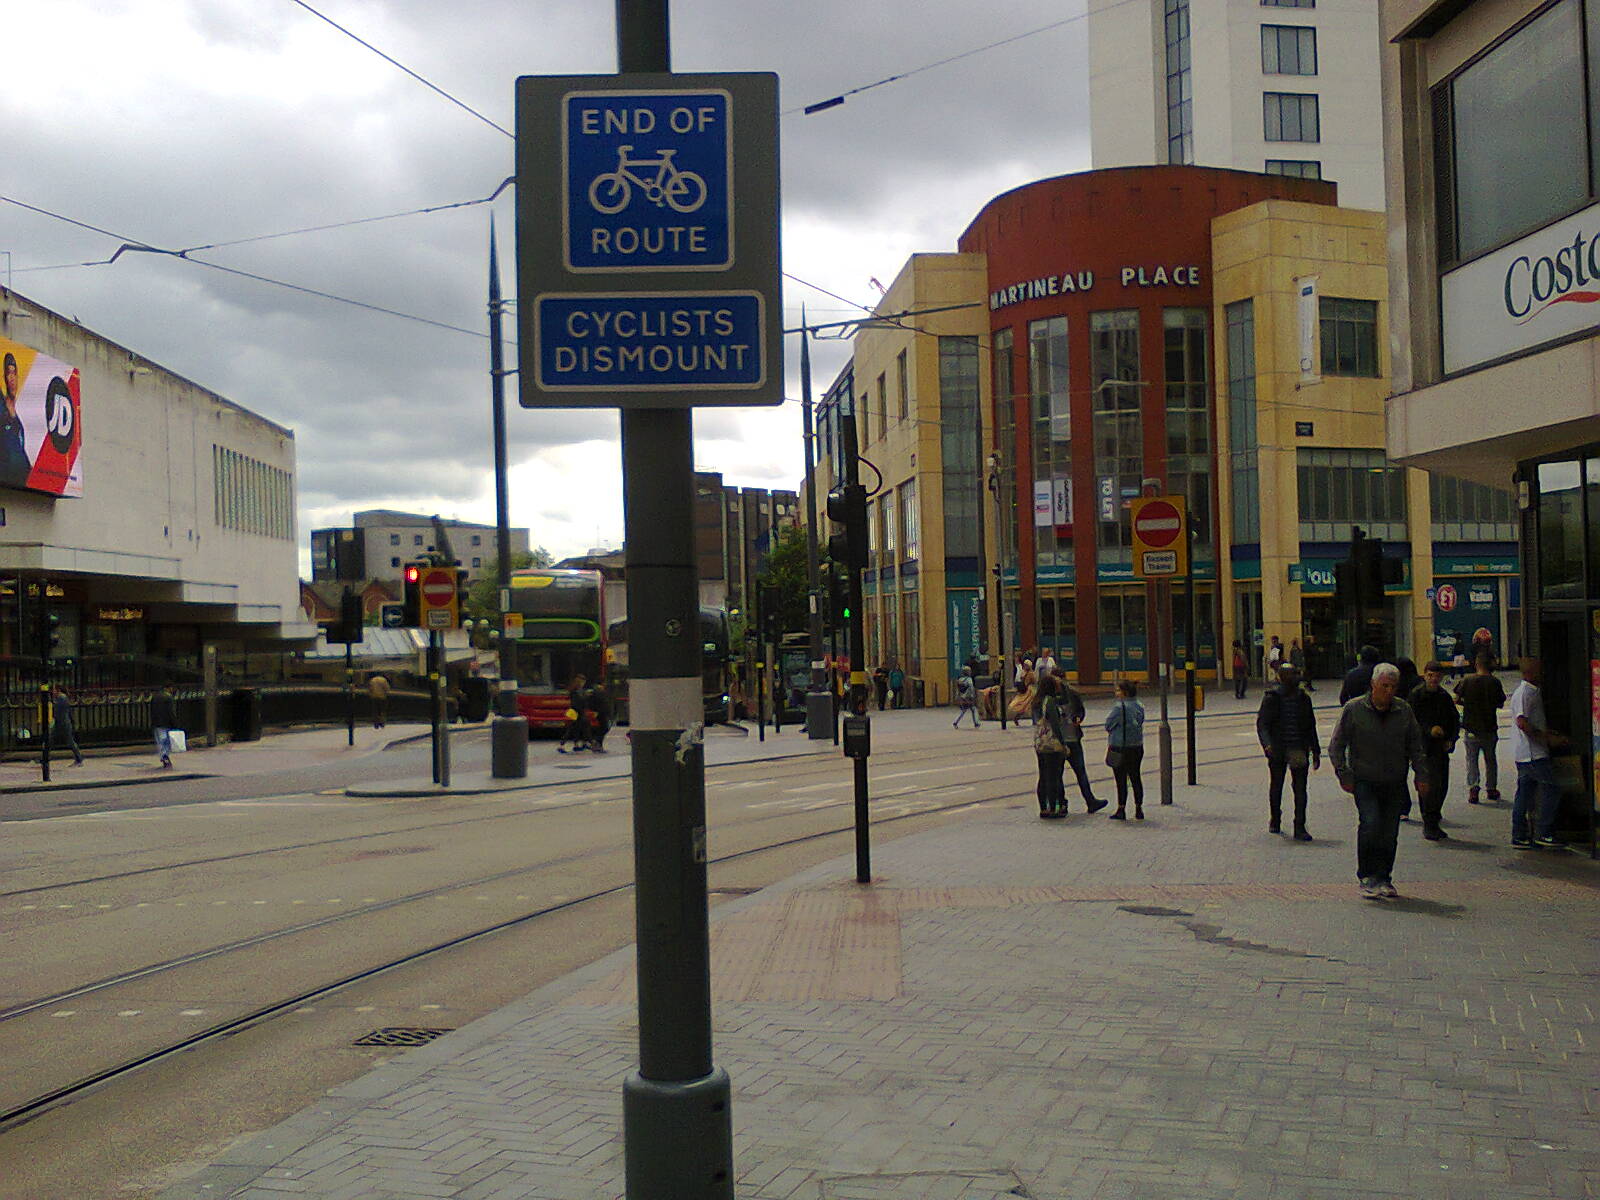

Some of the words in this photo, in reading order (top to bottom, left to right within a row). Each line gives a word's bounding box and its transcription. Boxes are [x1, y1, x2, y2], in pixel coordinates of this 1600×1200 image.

[582, 108, 655, 134] END
[670, 107, 715, 133] OF
[592, 227, 707, 253] ROUTE
[990, 271, 1094, 311] MARTINEAU
[1121, 265, 1200, 286] PLACE
[567, 309, 735, 338] CYCLISTS
[555, 345, 749, 372] DISMOUNT
[49, 393, 72, 437] JD
